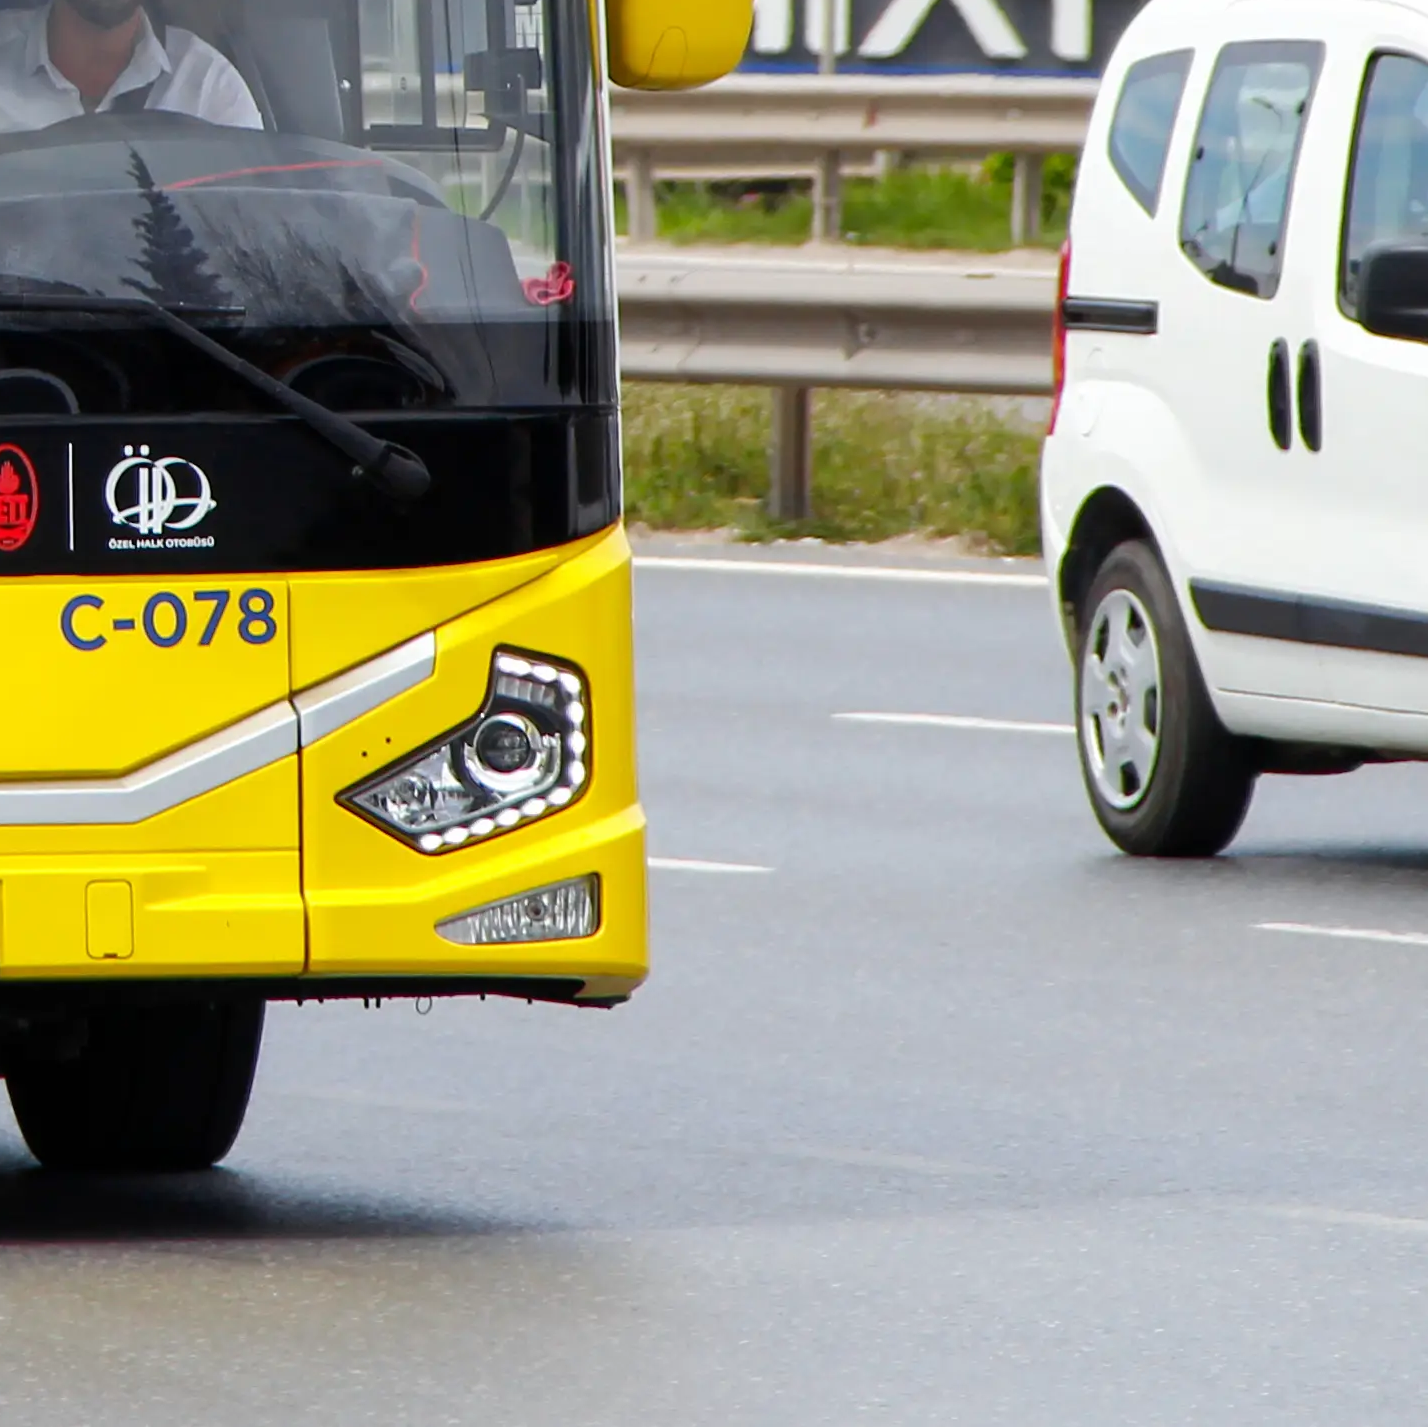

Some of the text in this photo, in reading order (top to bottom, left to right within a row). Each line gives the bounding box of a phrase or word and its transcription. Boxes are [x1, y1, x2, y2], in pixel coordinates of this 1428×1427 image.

[108, 535, 216, 550] ÖZEL HALK OTOBÜSÜ
[59, 588, 278, 652] C-078
